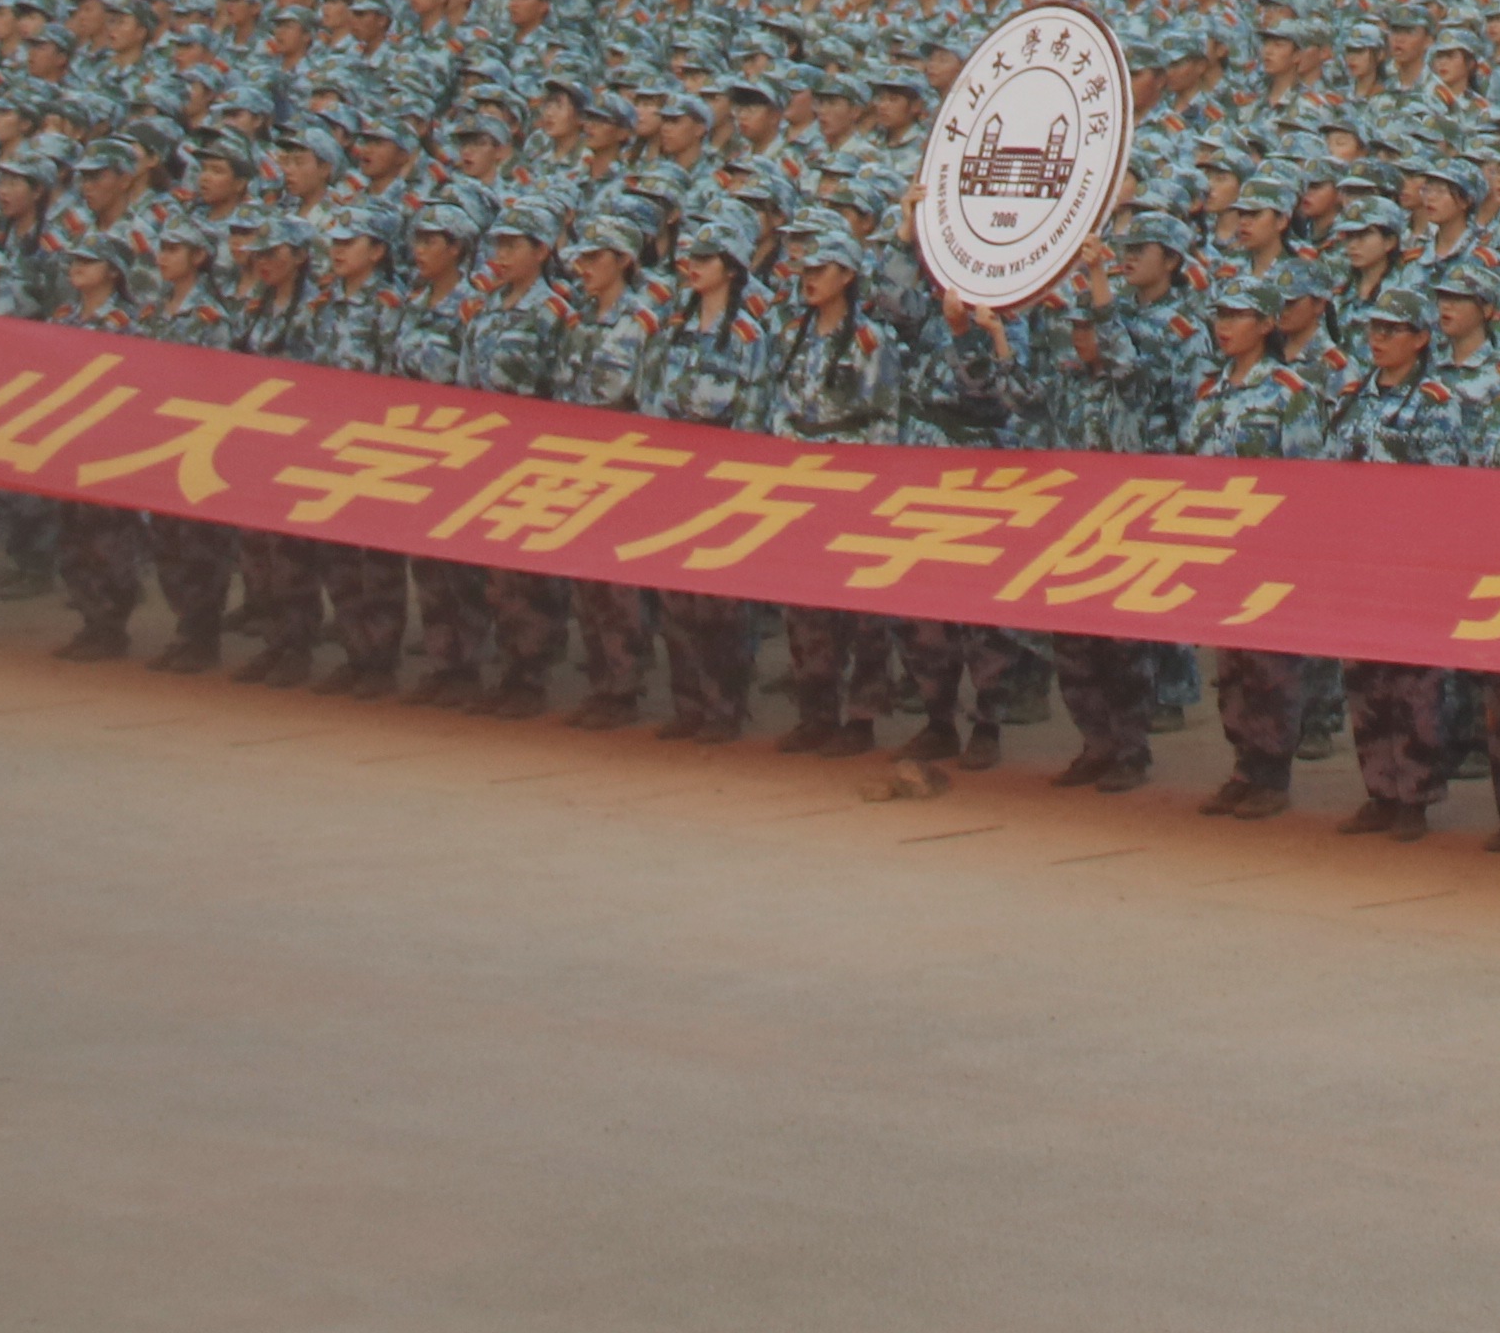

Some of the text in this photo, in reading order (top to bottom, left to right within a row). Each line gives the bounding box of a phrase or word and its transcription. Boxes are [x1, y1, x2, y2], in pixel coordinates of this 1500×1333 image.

[937, 163, 1095, 278] NANFANG COLLEGE OF SUN YAT-SEN UNIVERSITY
[990, 210, 1018, 228] 2006
